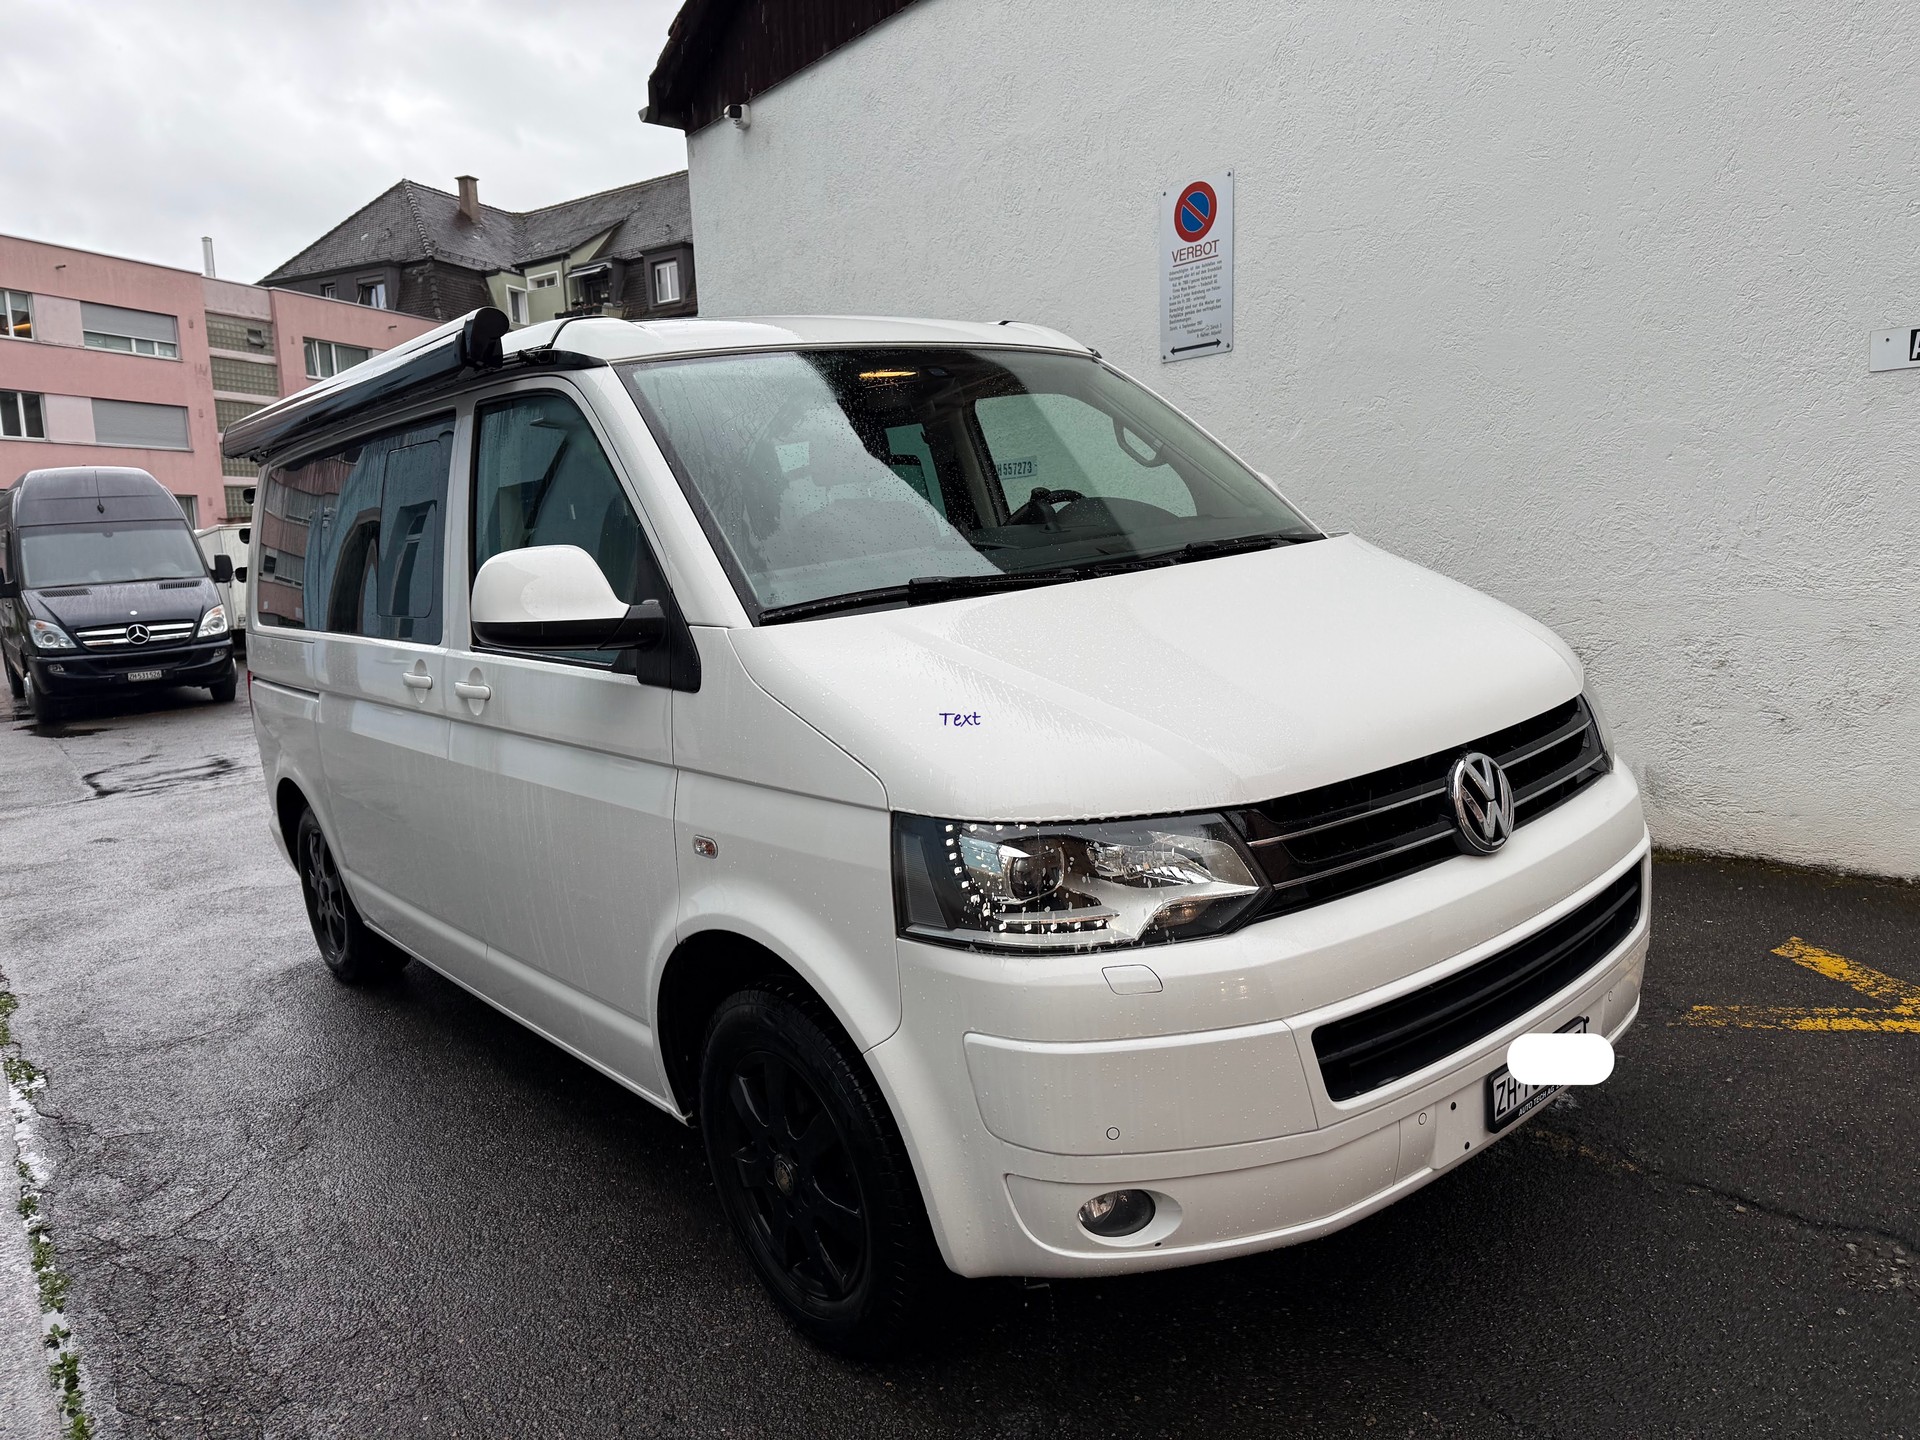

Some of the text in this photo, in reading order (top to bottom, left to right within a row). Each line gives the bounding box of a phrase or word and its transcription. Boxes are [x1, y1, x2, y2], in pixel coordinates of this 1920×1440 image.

[1172, 239, 1220, 263] VERBOT
[1457, 754, 1511, 849] VW
[1496, 1077, 1517, 1117] ZH
[1519, 1101, 1533, 1116] AUTO
[1533, 1090, 1547, 1106] TECH
[1547, 1086, 1555, 1096] AG
